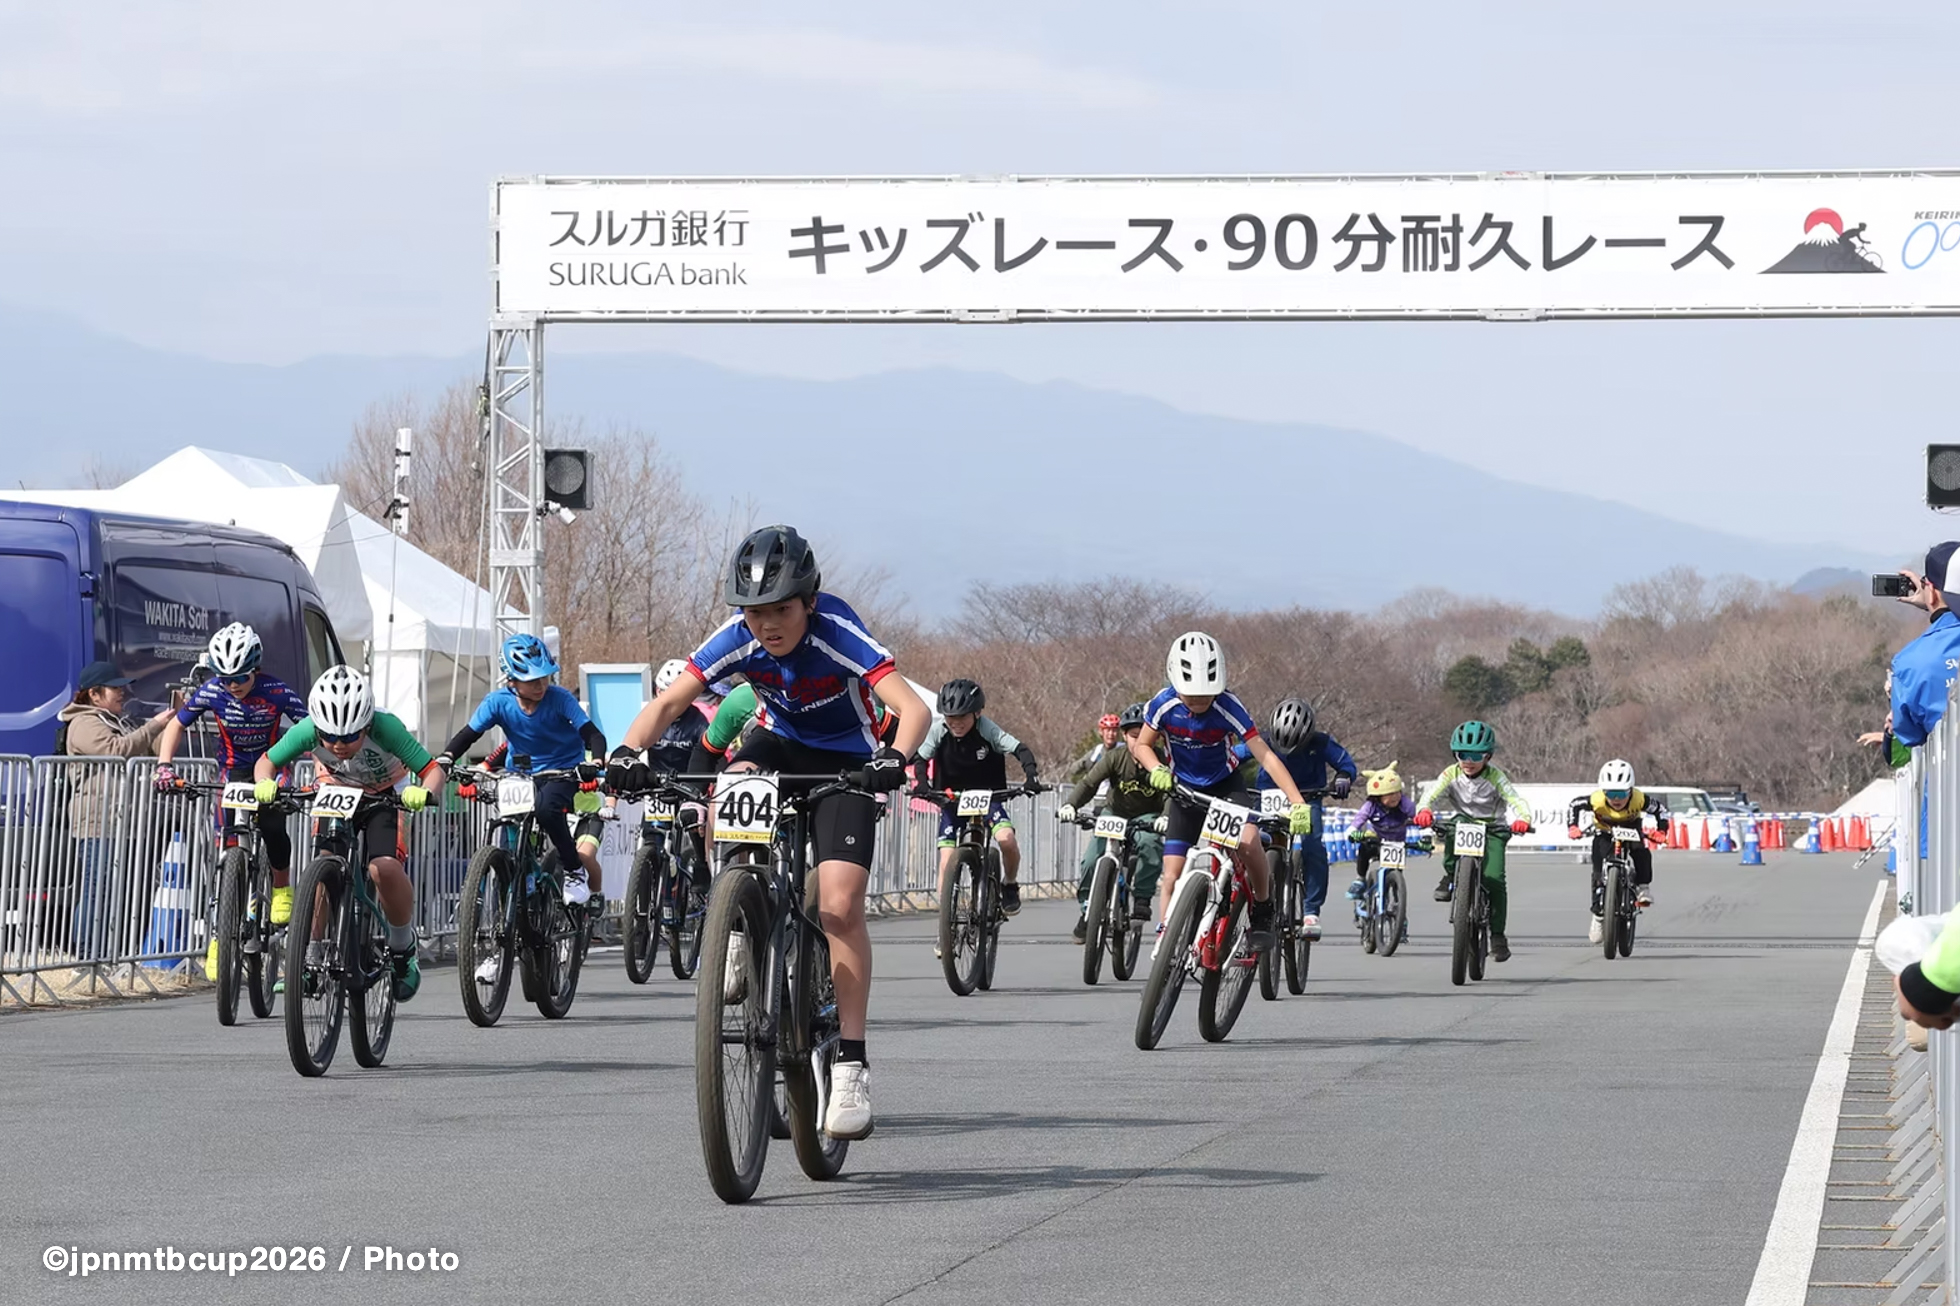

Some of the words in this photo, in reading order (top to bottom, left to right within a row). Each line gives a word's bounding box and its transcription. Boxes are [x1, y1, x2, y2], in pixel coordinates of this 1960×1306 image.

[549, 210, 750, 246] スルガ銀行
[549, 261, 676, 286] SURUGA
[681, 261, 749, 286] bank
[144, 600, 187, 629] WAKITA
[188, 605, 209, 631] Soft
[316, 793, 356, 811] 403
[501, 784, 532, 806] 402
[961, 795, 989, 810] 305
[1264, 795, 1292, 812] 304
[718, 791, 774, 828] 404
[1097, 820, 1125, 833] 309
[1207, 809, 1243, 838] 306
[1457, 830, 1484, 848] 308
[1616, 830, 1638, 839] 202
[1383, 847, 1403, 863] 201
